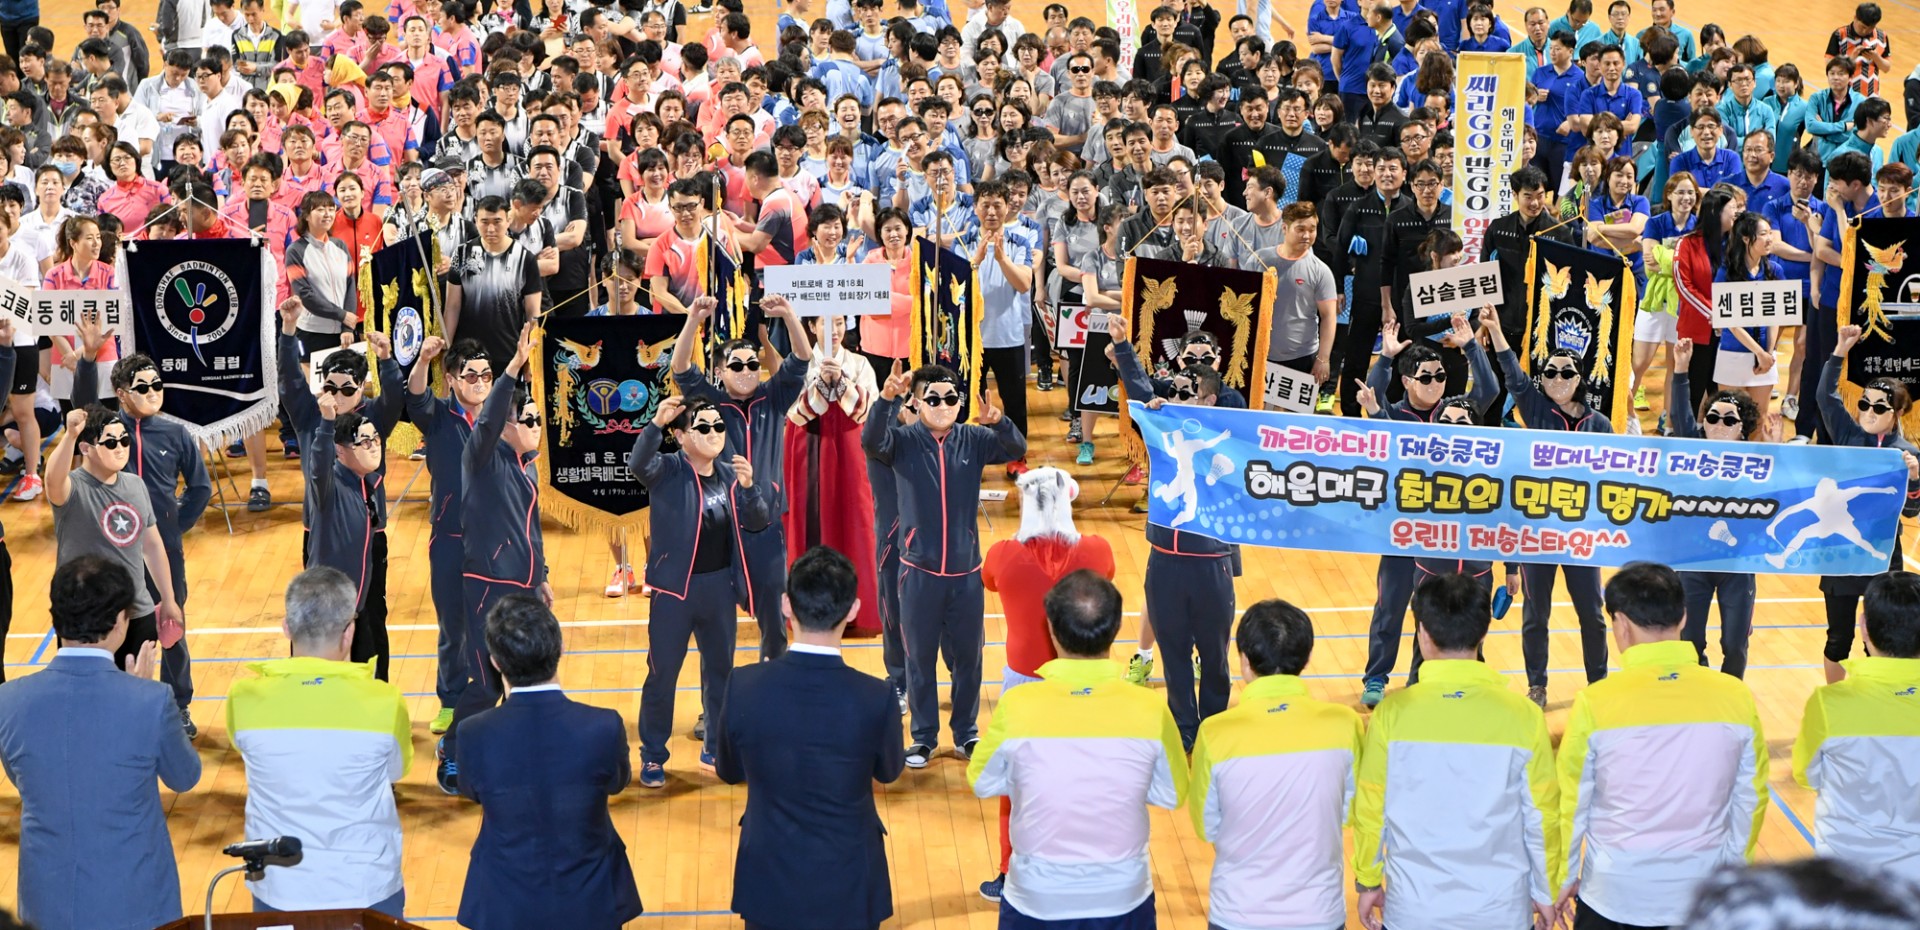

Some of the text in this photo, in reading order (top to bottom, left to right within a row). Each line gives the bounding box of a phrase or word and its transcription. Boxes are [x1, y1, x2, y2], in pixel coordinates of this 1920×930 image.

[1500, 108, 1515, 167] 해운대구
[156, 261, 239, 310] DONGHAE BADMINTON CLUB
[837, 278, 864, 288] 제18회
[874, 290, 890, 299] 대회
[1416, 273, 1498, 306] 삼솔클럽
[1718, 289, 1797, 318] 센텀클럽
[166, 324, 227, 342] Since 2004
[161, 355, 240, 372] 동해 클럽
[1260, 427, 1771, 479] 까리하다!! 재송클럽 뽀대난다!! 재송클럽
[1248, 463, 1385, 506] 해운대구
[1398, 472, 1500, 510] 최고의
[1515, 479, 1586, 518] 민턴
[1393, 521, 1458, 549] 우린!!
